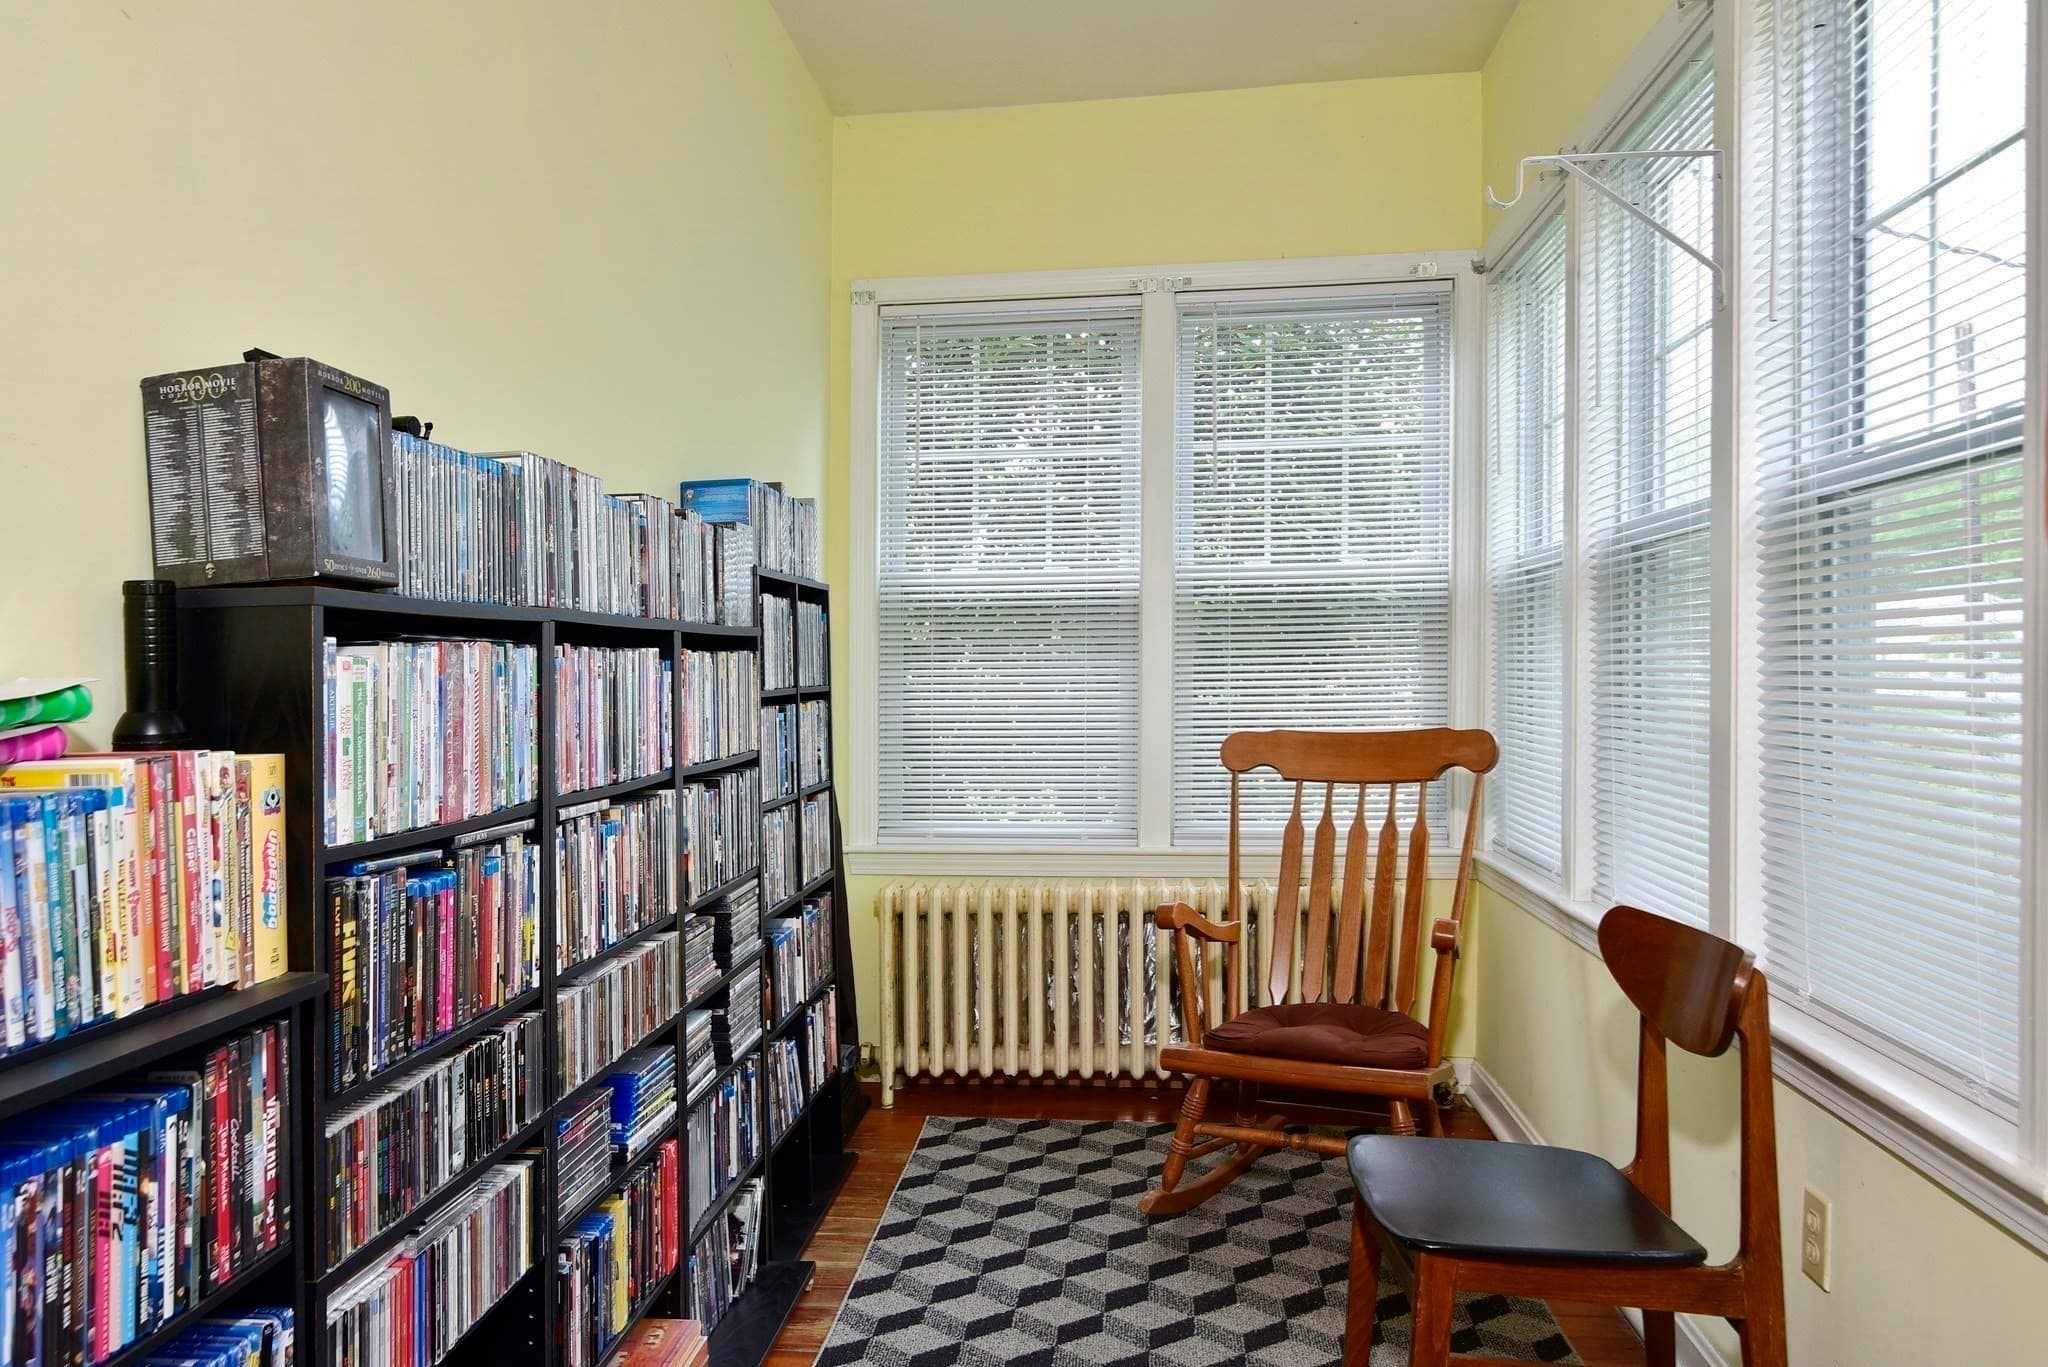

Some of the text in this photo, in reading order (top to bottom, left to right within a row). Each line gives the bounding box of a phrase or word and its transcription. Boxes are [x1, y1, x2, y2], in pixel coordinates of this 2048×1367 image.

[159, 377, 238, 395] HORROR MOVIE
[160, 385, 237, 400] COLLECTION
[171, 373, 225, 404] 200
[318, 369, 386, 401] HORROR 200 MOVIES
[324, 558, 335, 572] 50
[367, 565, 382, 579] 260
[446, 679, 454, 724] SANTA
[185, 828, 198, 874] Casper
[460, 834, 476, 846] JERSEY
[261, 828, 279, 929] UNDERDOG
[103, 887, 113, 937] WIZARD
[118, 879, 129, 932] WIZARD
[160, 894, 169, 920] BUGS
[334, 896, 342, 938] ELVIS
[53, 905, 64, 953] GREMLINS
[161, 921, 170, 952] BUNNY
[55, 956, 67, 998] GREMLINS
[342, 919, 357, 1004] ELVIS
[334, 1022, 342, 1052] ESSENTIAL
[230, 1118, 241, 1181] Cocktail
[266, 1095, 277, 1181] VALKYRIE
[209, 1119, 218, 1216] COLLATERAL
[158, 1226, 166, 1285] FALLOUT
